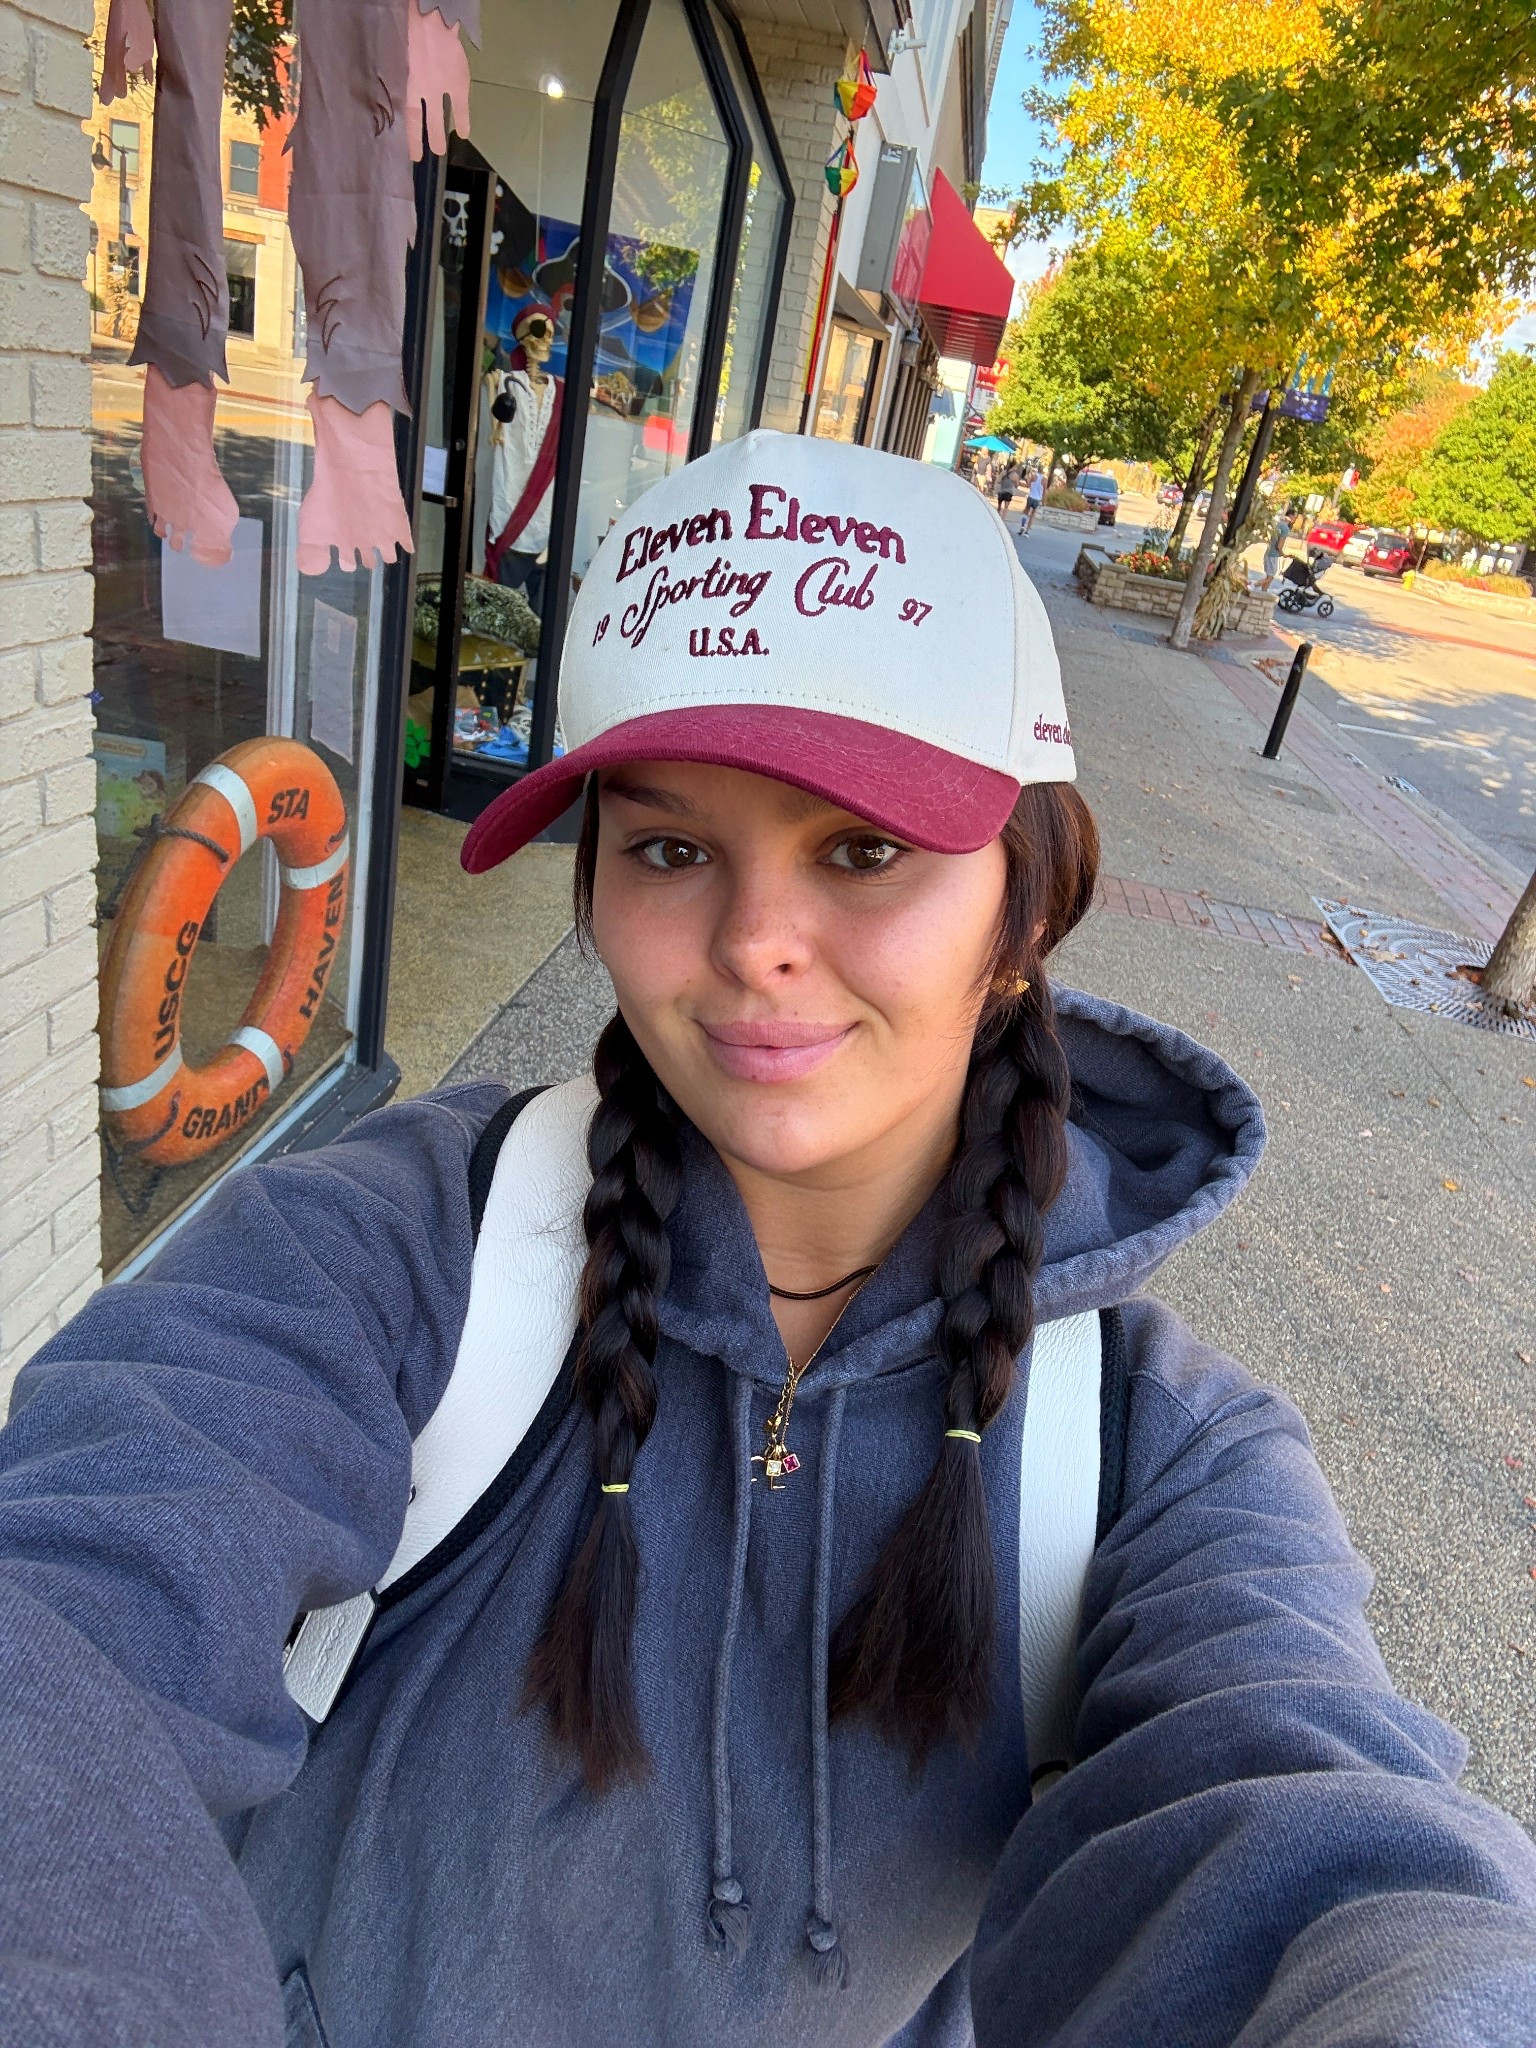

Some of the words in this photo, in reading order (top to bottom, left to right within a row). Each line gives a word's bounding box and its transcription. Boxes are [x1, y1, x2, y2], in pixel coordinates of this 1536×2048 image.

[615, 508, 733, 583] Eleven
[744, 484, 907, 564] Eleven
[592, 613, 611, 647] 19
[620, 556, 772, 649] Sporting
[794, 556, 879, 617] Club
[898, 598, 933, 626] 97
[689, 626, 770, 657] U.S.A.
[267, 788, 310, 825] STA
[155, 919, 199, 1061] USCG
[299, 872, 344, 1020] HAVEN
